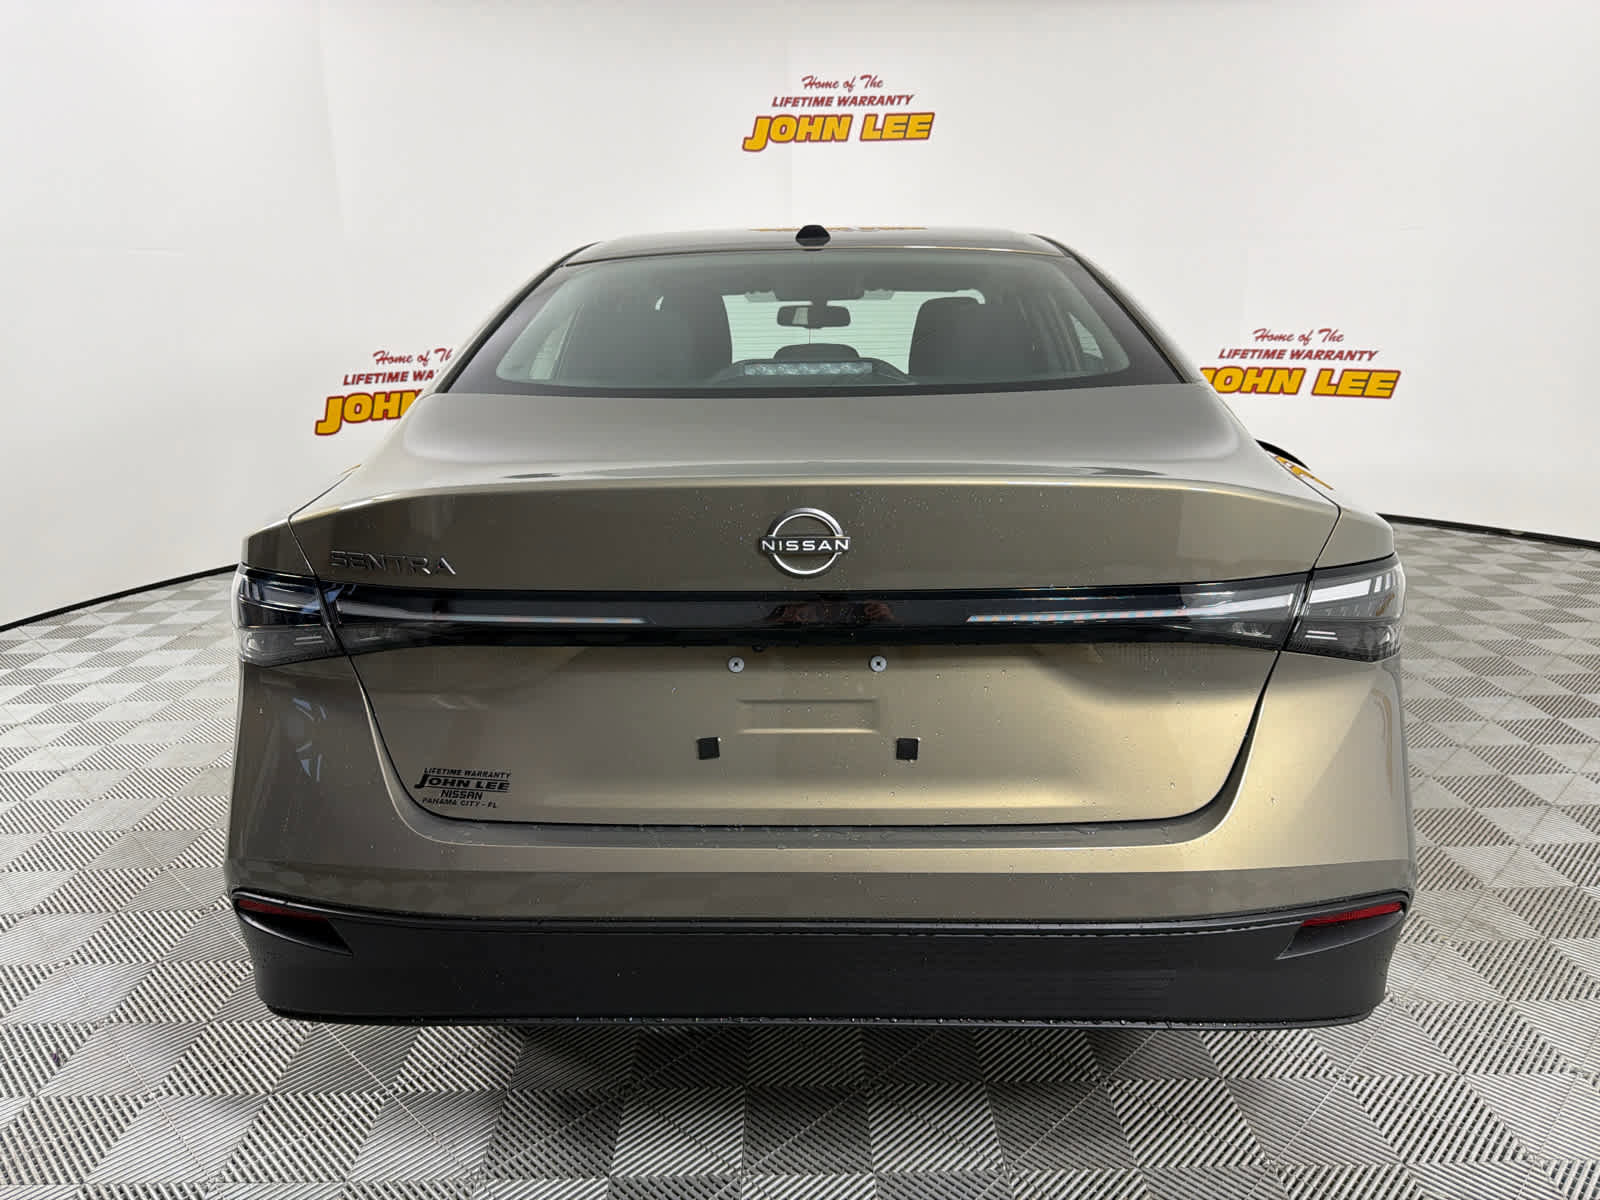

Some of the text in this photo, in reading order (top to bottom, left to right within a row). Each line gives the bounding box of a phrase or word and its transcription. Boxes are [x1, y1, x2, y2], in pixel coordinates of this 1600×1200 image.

[801, 74, 883, 92] Home of The
[771, 94, 914, 107] LIFETIME WARRANTY
[742, 112, 935, 152] JOHN LEE
[1252, 328, 1344, 345] Home of The
[372, 350, 413, 365] Home
[417, 350, 430, 366] of
[1218, 348, 1379, 361] LIFETIME WARRANTY
[343, 370, 409, 386] LIFETIME
[1311, 368, 1401, 399] LEE
[761, 539, 849, 551] NISSAN
[329, 550, 457, 575] SENTRA
[424, 767, 511, 779] LIFETIME WARRANTY
[414, 774, 511, 791] JOHN LEE
[440, 789, 483, 800] NISSAN
[422, 797, 457, 806] PANAMA
[487, 801, 497, 809] FL
